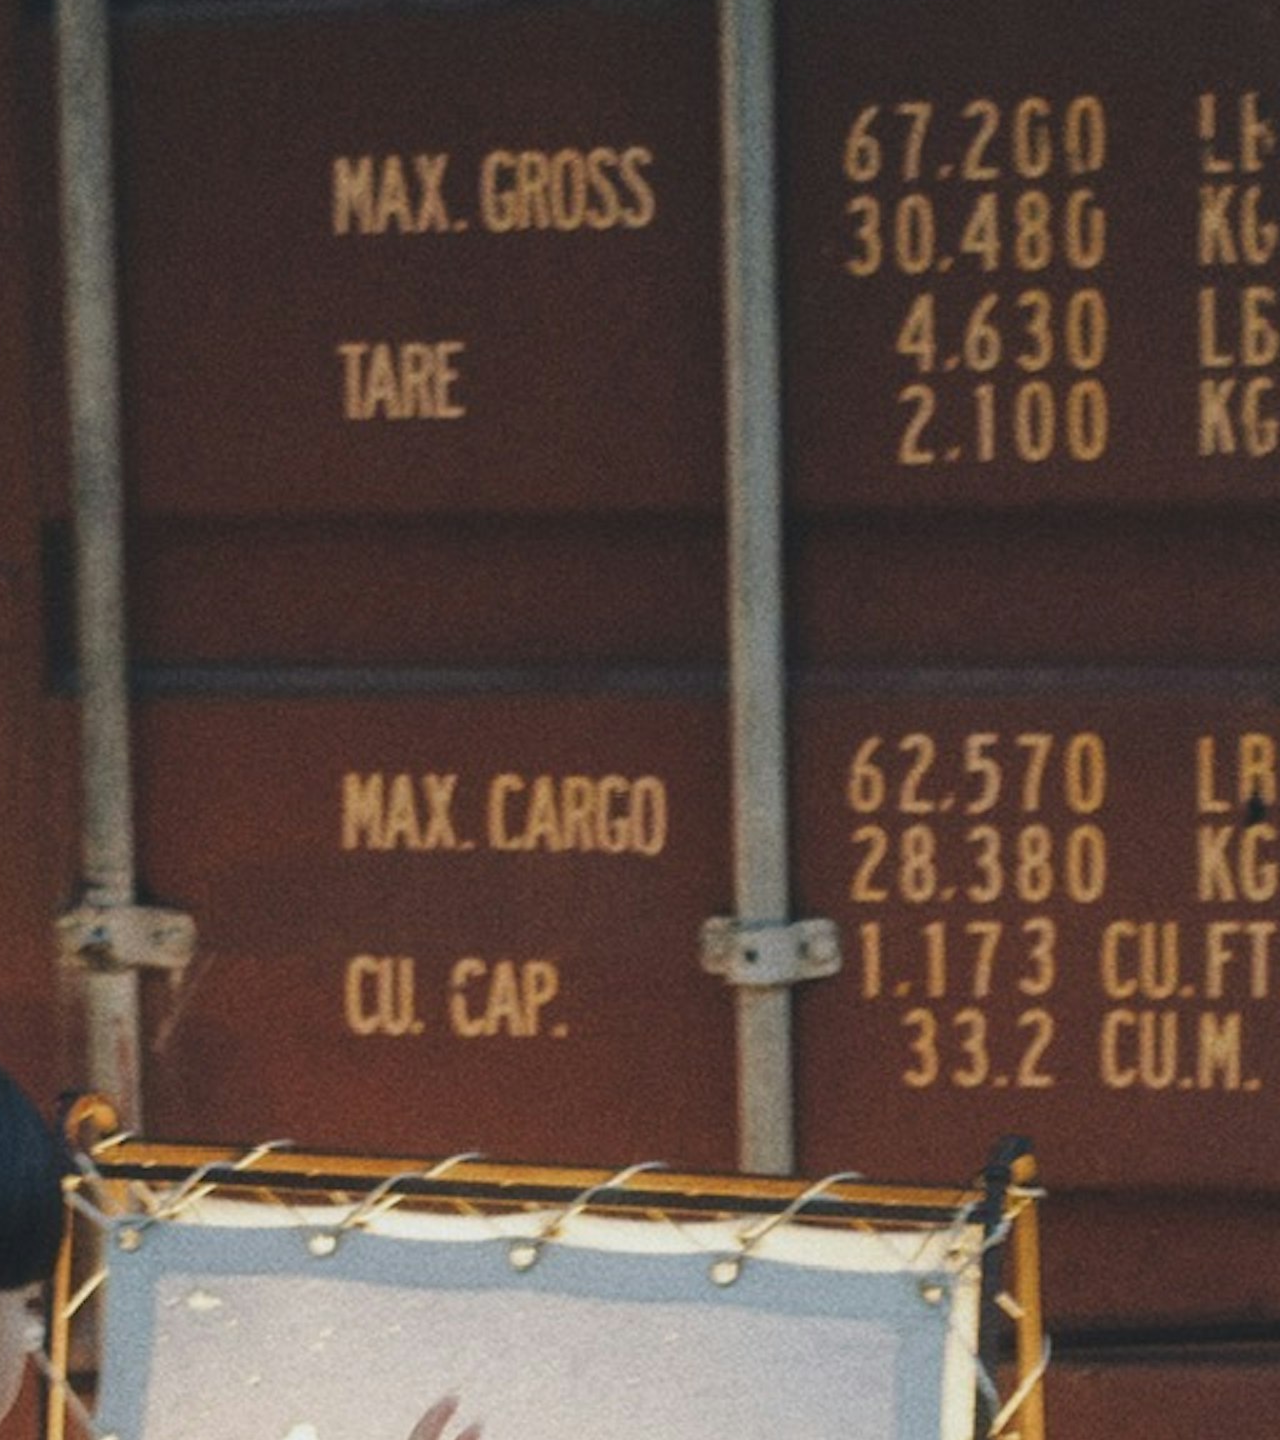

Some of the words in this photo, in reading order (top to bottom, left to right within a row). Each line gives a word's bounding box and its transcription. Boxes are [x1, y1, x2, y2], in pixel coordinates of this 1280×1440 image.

[331, 154, 469, 235] MAX.
[481, 147, 657, 232] GROSS
[844, 190, 1108, 276] 30.480
[1198, 184, 1280, 265] KG
[897, 288, 1108, 372] 4.630
[338, 340, 466, 420] TARE
[896, 379, 1108, 466] 2.100
[1198, 376, 1280, 457] KG
[341, 772, 474, 852] MAX.
[486, 773, 668, 856] CARGO
[847, 733, 1108, 814] 62.570
[849, 824, 1108, 904] 28.380
[1197, 825, 1279, 904] KG
[344, 957, 424, 1036] CU.
[450, 958, 569, 1038] CAP.
[857, 918, 1058, 1000] 1.173
[901, 1008, 1056, 1089] 33.2
